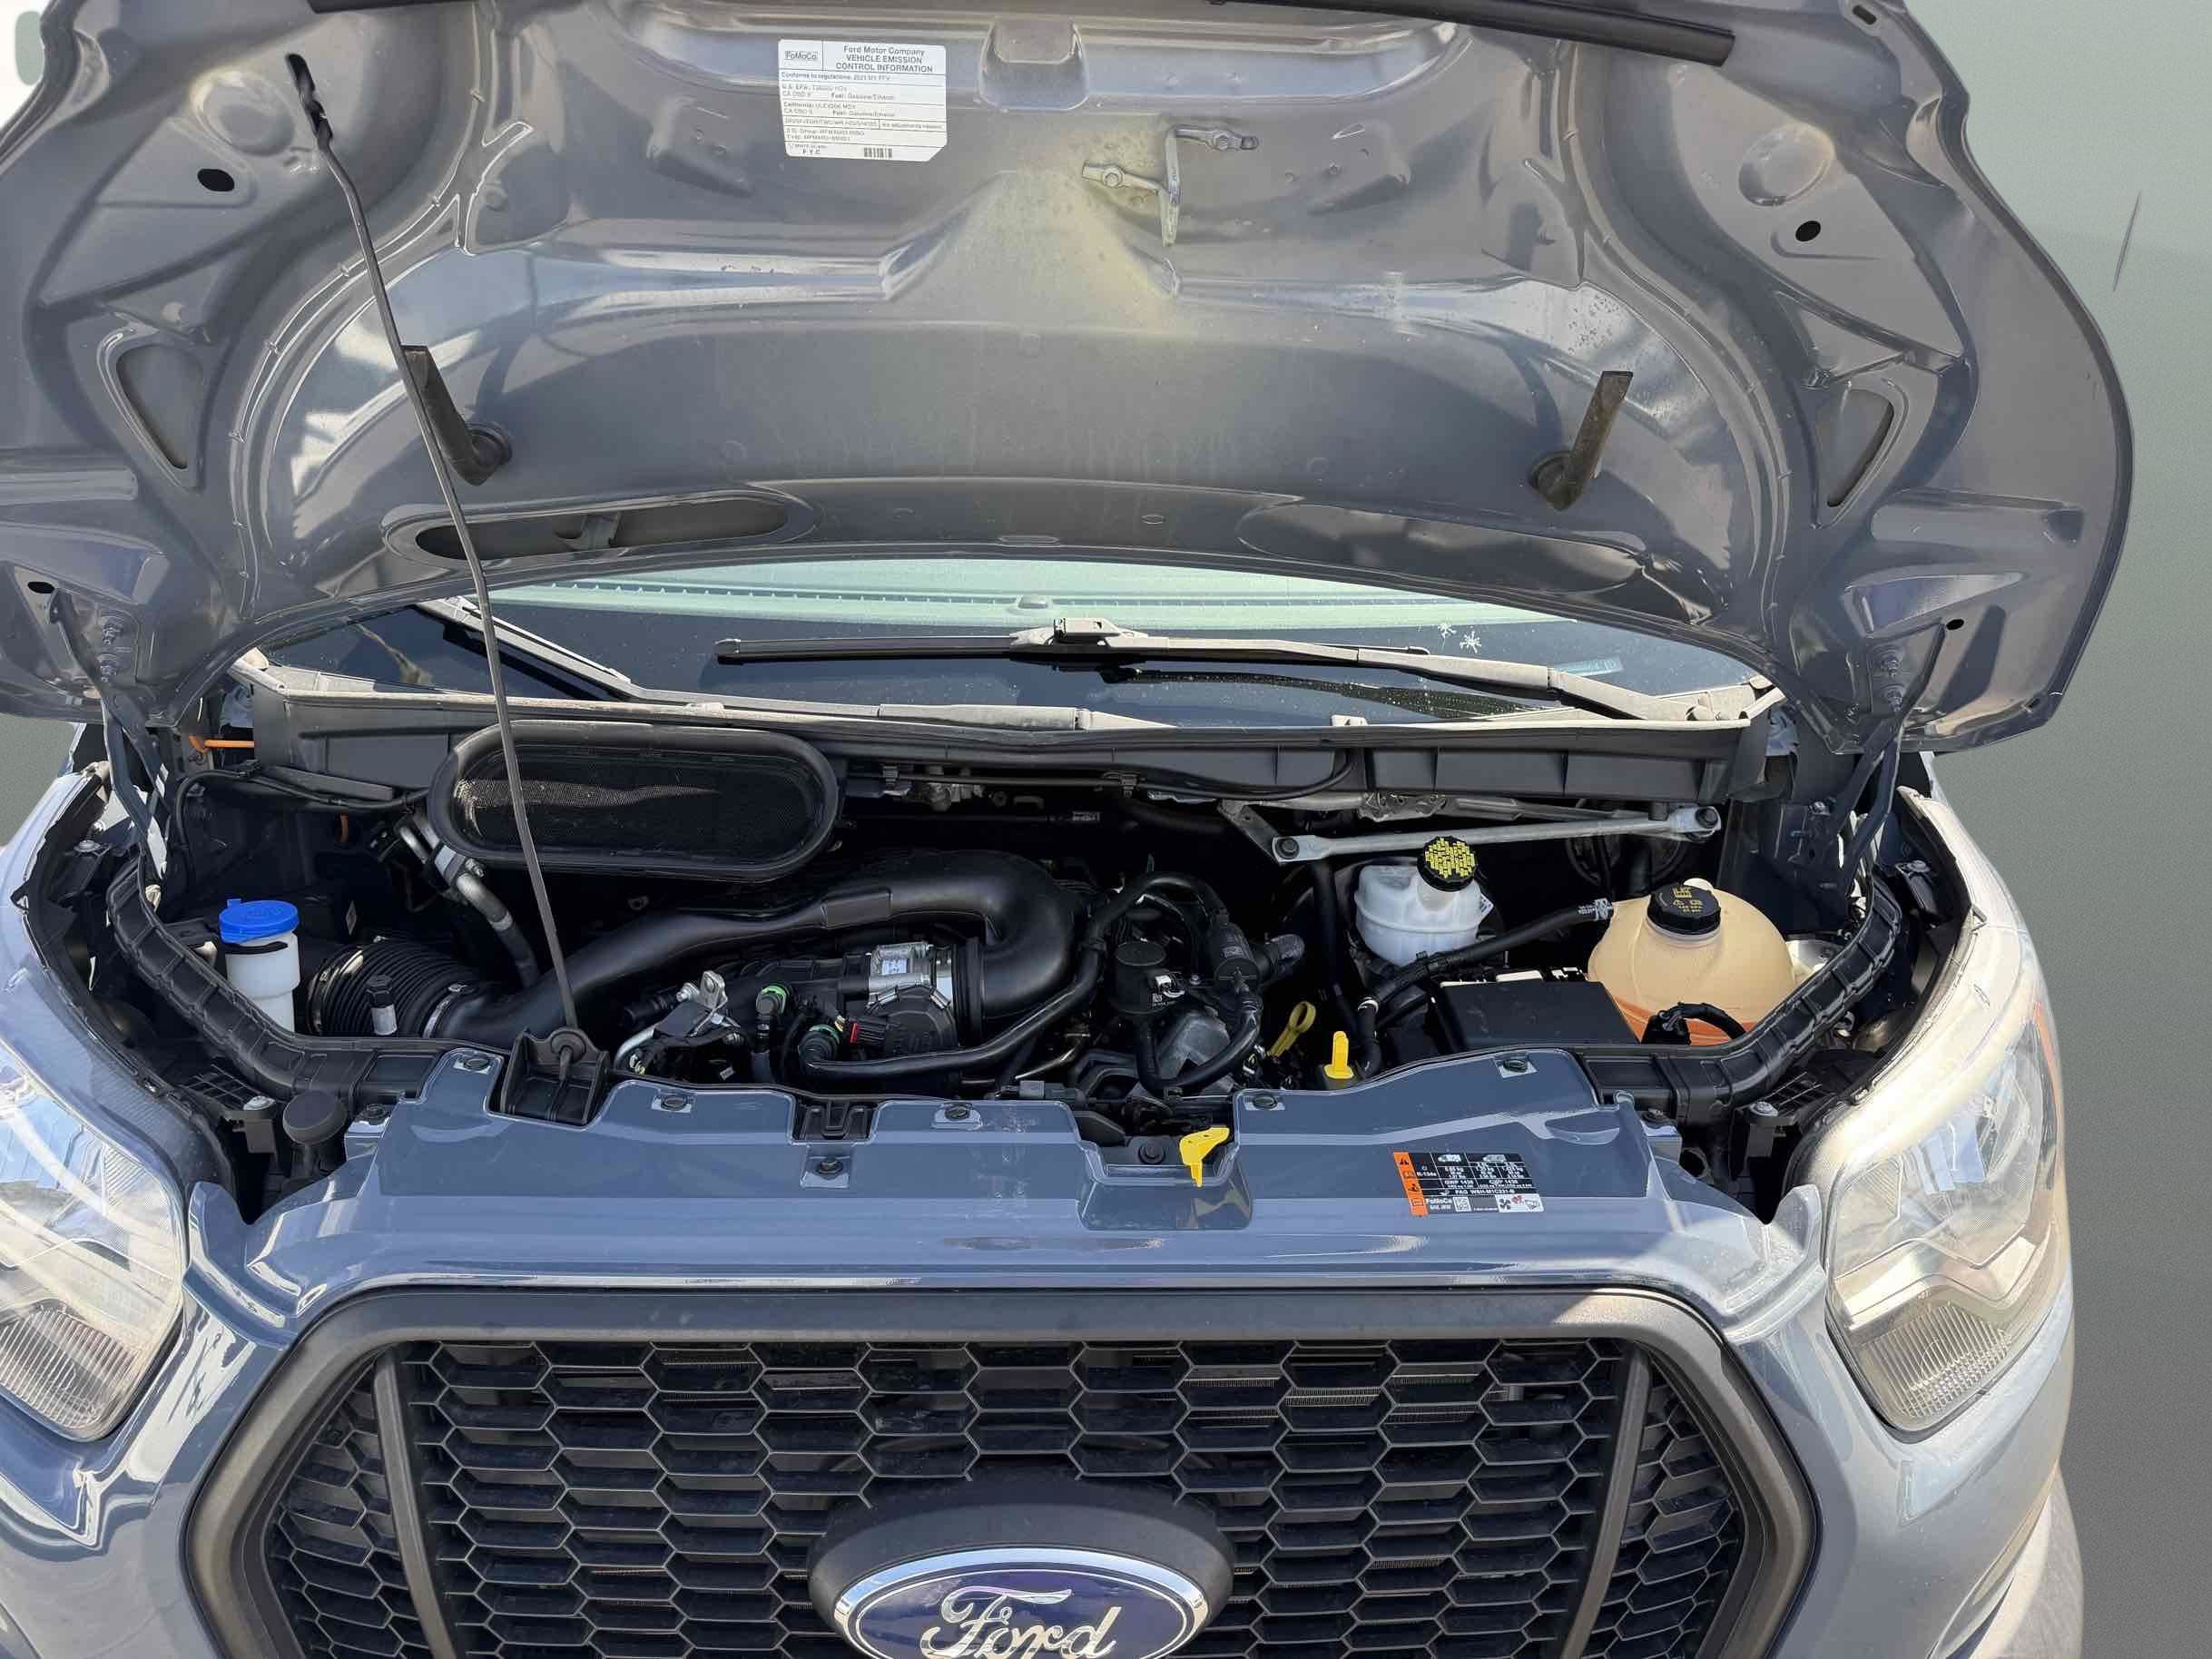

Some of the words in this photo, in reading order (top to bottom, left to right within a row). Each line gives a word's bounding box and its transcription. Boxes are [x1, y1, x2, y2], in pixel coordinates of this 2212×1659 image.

[784, 50, 818, 61] FoMoCo
[843, 45, 861, 54] Ford
[863, 46, 886, 54] Motor
[889, 47, 925, 56] Company
[846, 54, 880, 63] VEHICLE
[882, 56, 922, 64] EMISSION
[836, 63, 875, 71] CONTROL
[877, 64, 933, 73] INFORMATION
[919, 1585, 1123, 1659] Ford
